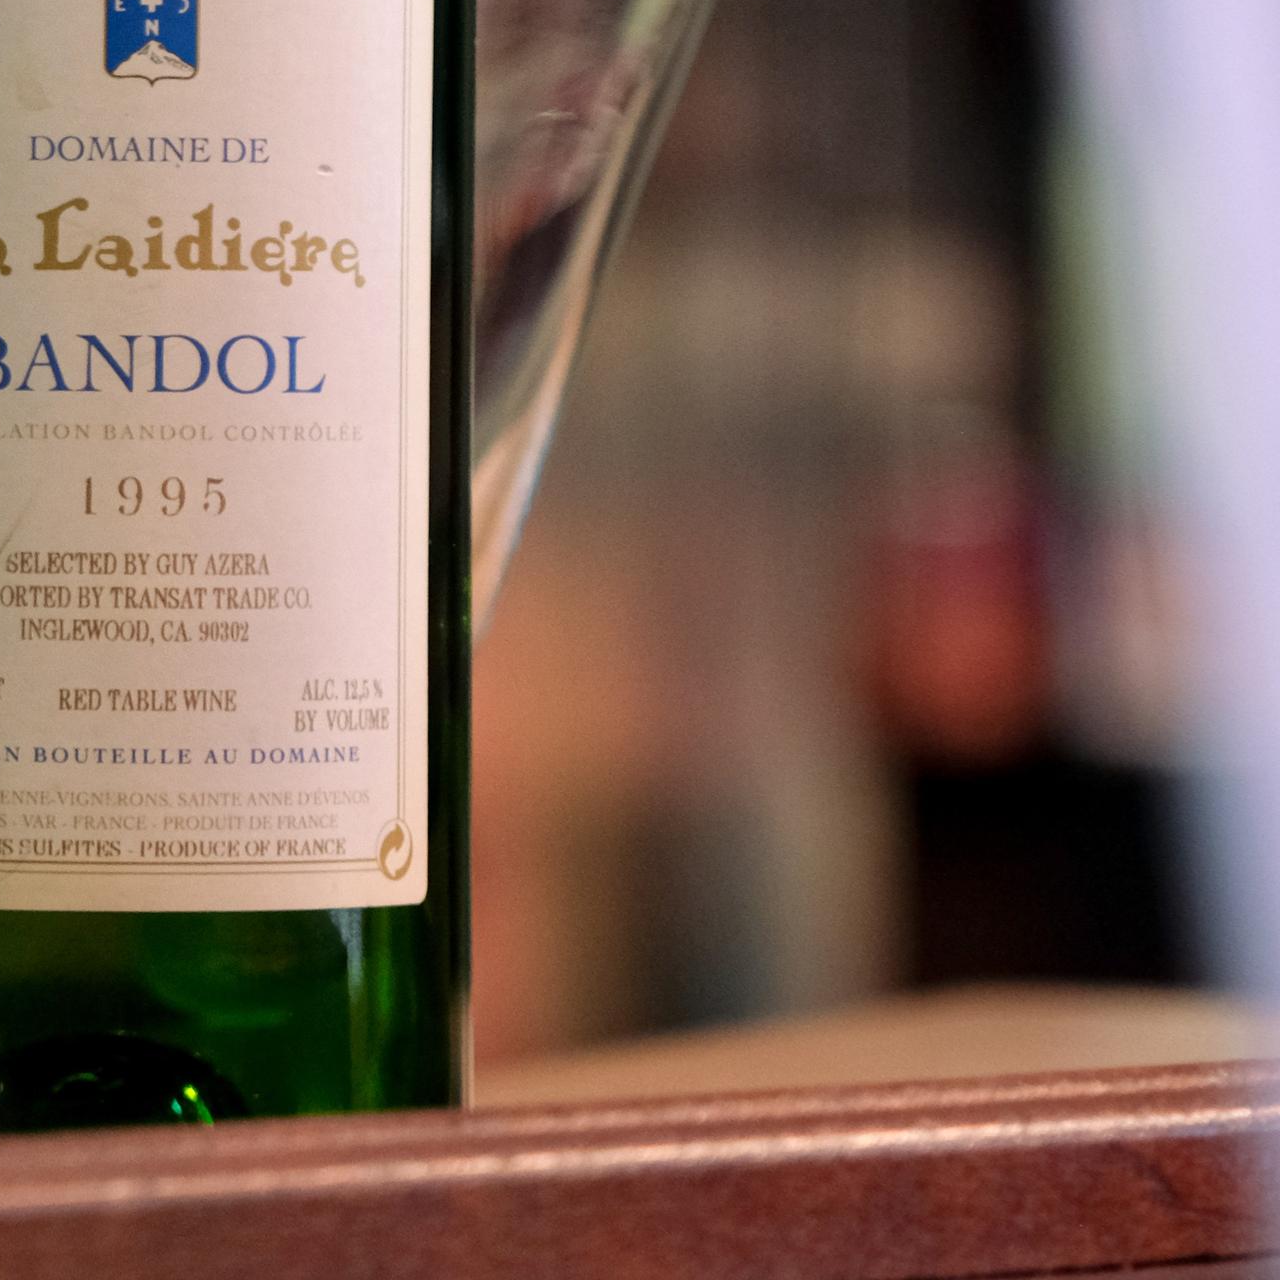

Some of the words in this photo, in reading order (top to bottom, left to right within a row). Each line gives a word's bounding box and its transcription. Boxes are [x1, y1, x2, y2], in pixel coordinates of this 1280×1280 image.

[144, 18, 161, 38] N
[28, 135, 209, 163] DOMAINE
[222, 137, 270, 165] DE
[103, 423, 215, 443] BANDOL
[82, 475, 229, 518] 1995
[6, 551, 118, 576] SELECTED
[124, 553, 151, 576] BY
[155, 553, 201, 576] GUY
[204, 554, 271, 577] AZERA
[77, 586, 104, 609] BY
[110, 586, 209, 610] TRANSAT
[212, 587, 280, 610] TRADE
[283, 587, 314, 610] CO.
[20, 618, 156, 646] INGLEWOOD,
[198, 621, 251, 644] 90302
[57, 687, 103, 712] RED
[107, 687, 179, 713] TABLE
[181, 687, 238, 712] WINE
[301, 678, 338, 702] ALC.
[293, 709, 318, 733] BY
[326, 708, 391, 732] VOLUME
[32, 744, 193, 766] BOUTEILLE
[203, 744, 240, 765] AU
[248, 743, 362, 765] DOMAINE
[176, 789, 242, 809] SAINTE
[245, 790, 295, 809] ANNE
[21, 813, 59, 830] VAR
[71, 813, 149, 832] FRANCE
[162, 815, 244, 833] PRODUIT
[249, 815, 273, 832] DE
[276, 813, 339, 831] FRANCE
[17, 837, 123, 859] SULFITES
[138, 839, 241, 859] PRODUCE
[243, 838, 273, 858] OF
[275, 838, 348, 858] FRANCE
